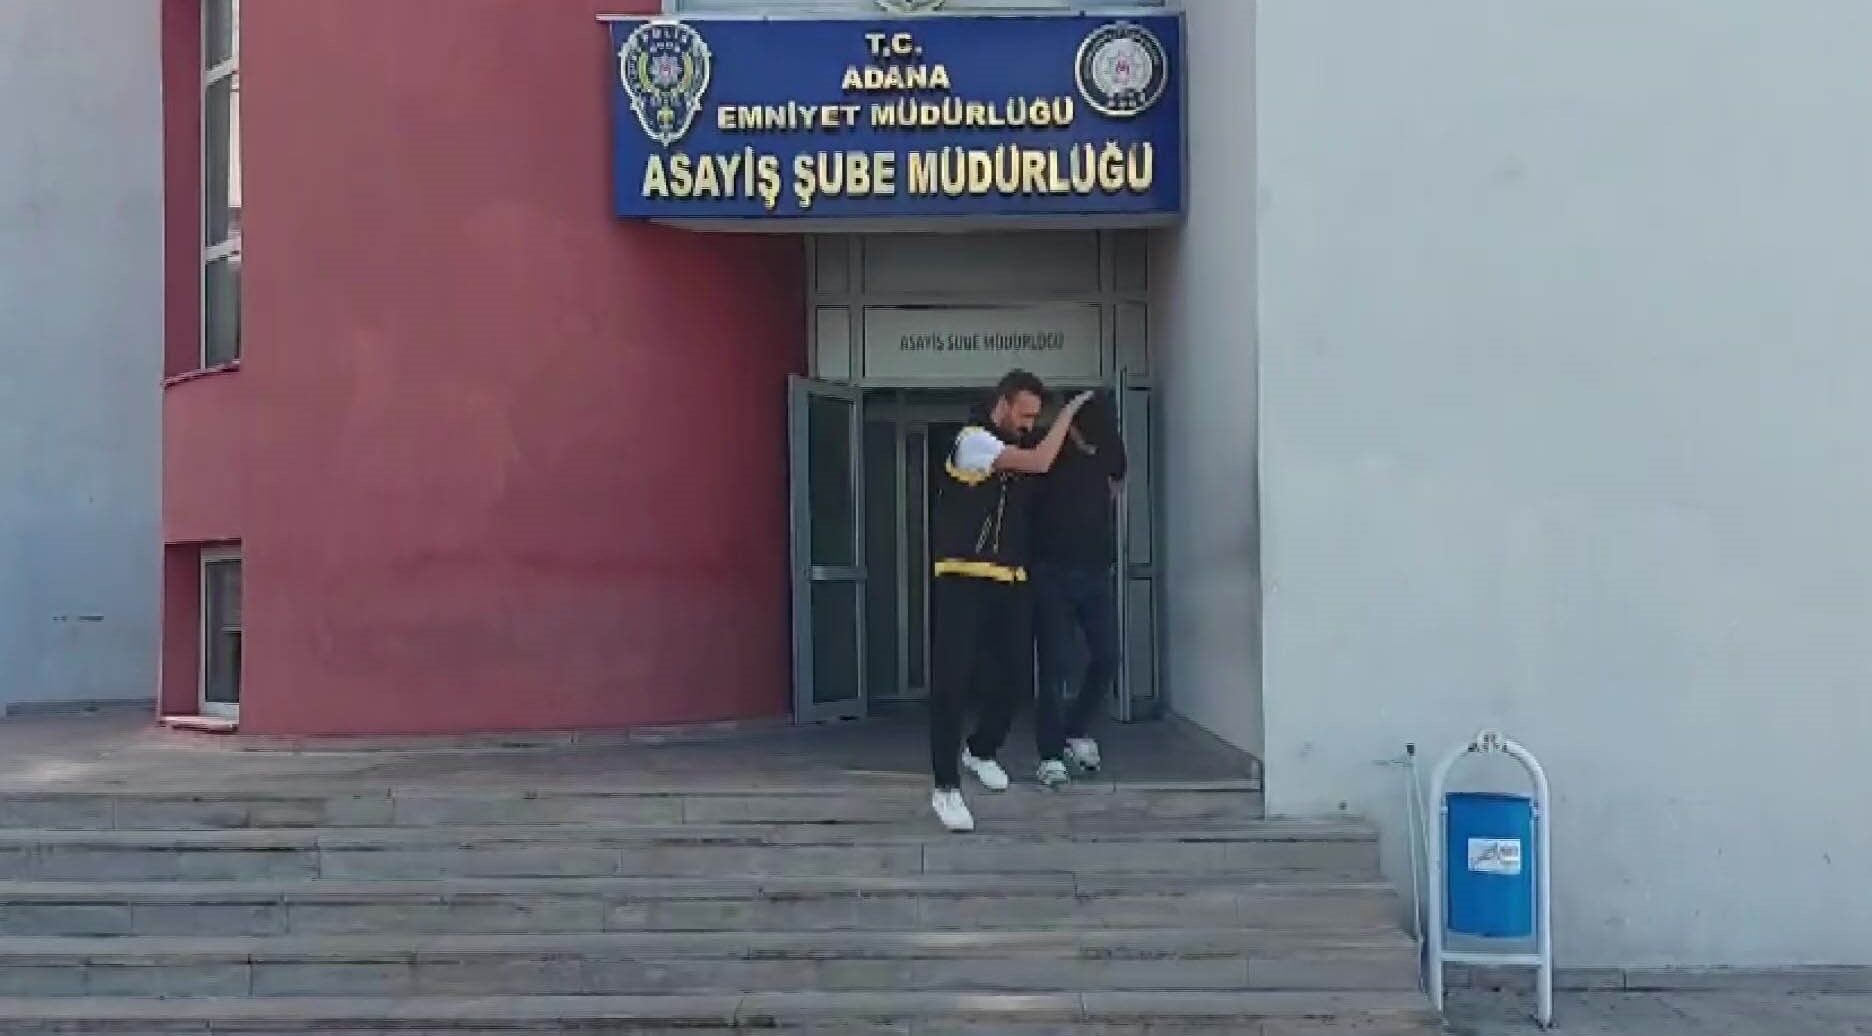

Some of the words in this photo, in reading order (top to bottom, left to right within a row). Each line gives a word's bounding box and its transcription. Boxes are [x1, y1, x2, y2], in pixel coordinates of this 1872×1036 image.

[865, 33, 922, 55] T.C.
[842, 65, 950, 90] ADANA
[717, 101, 862, 130] EMNİYET
[871, 96, 1074, 128] MÜDÜRLÜĞÜ
[642, 146, 781, 209] ASAYİŞ
[794, 150, 896, 209] ŞUBE
[908, 139, 1154, 196] MÜDÜRLÜĞÜ
